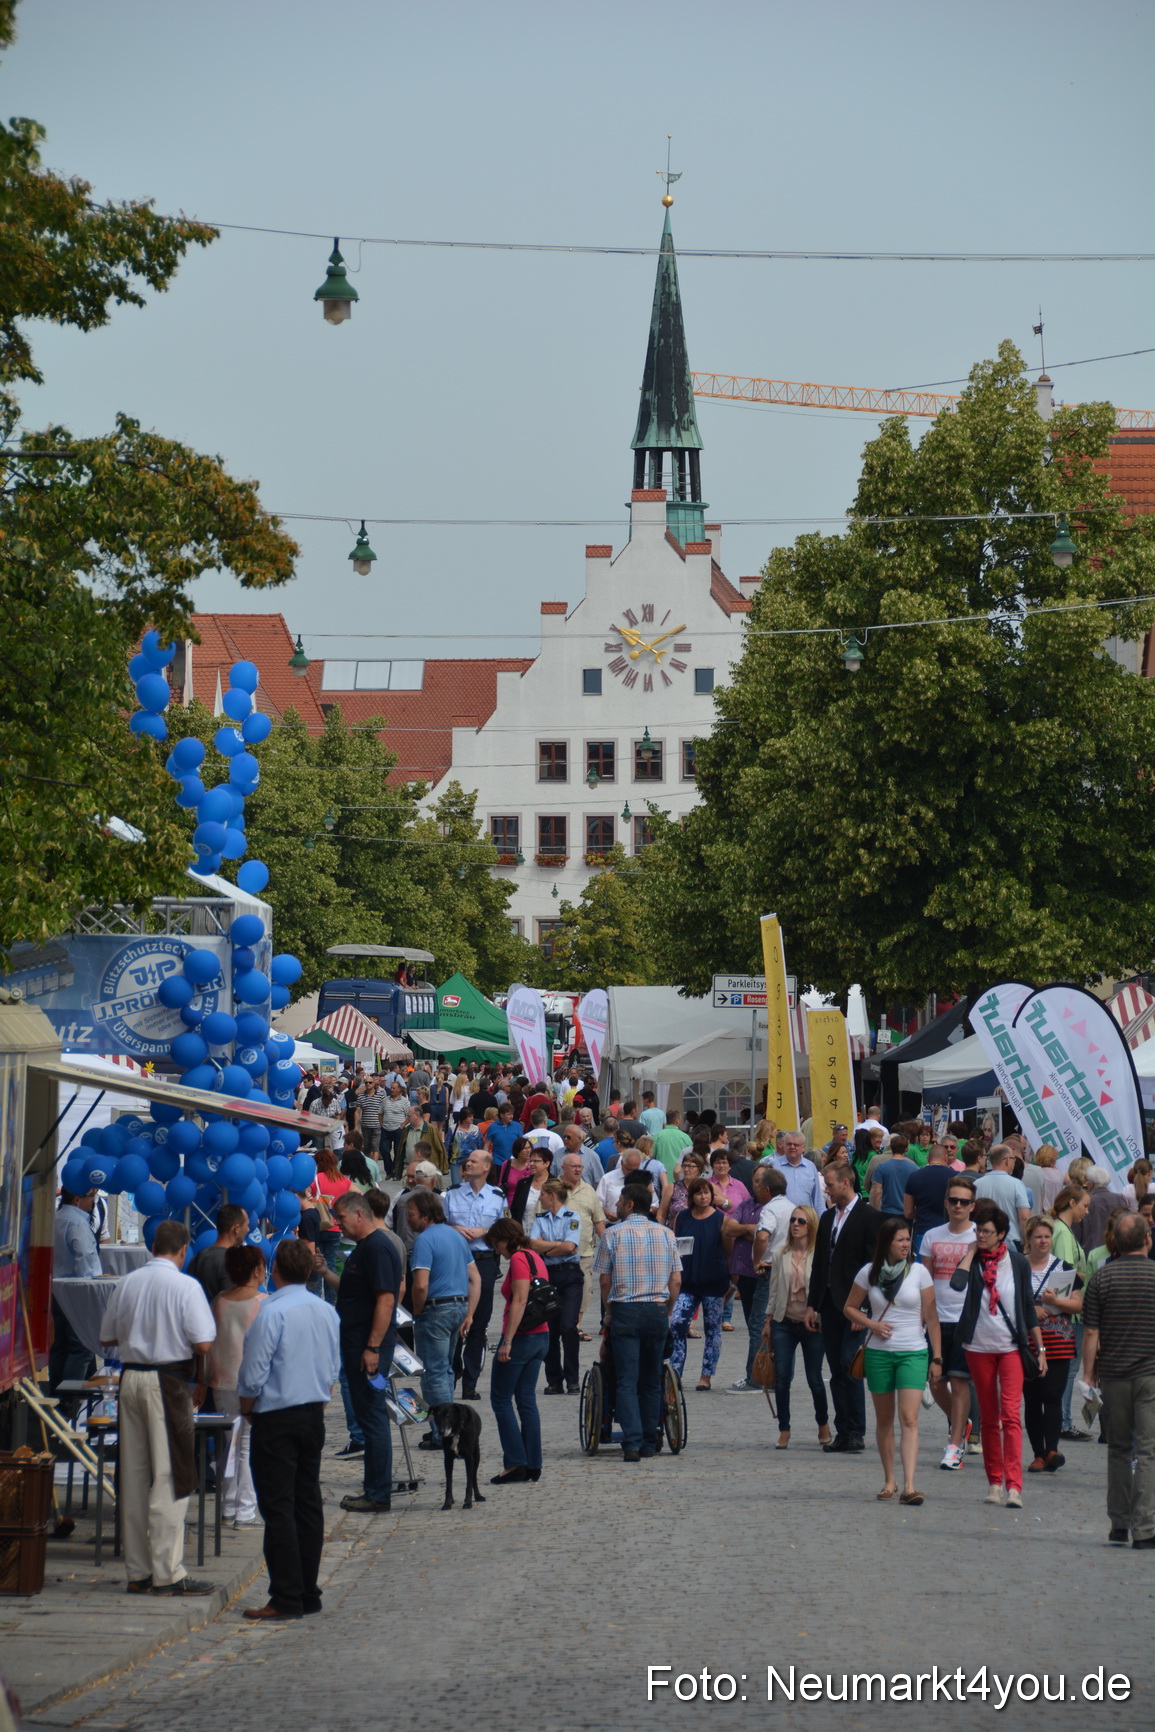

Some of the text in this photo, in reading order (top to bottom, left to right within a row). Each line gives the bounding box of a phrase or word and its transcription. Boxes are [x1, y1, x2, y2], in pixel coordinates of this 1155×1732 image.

[104, 941, 192, 994] Blitzschutztech
[728, 979, 767, 990] Parkleitsys
[52, 1022, 93, 1043] utz
